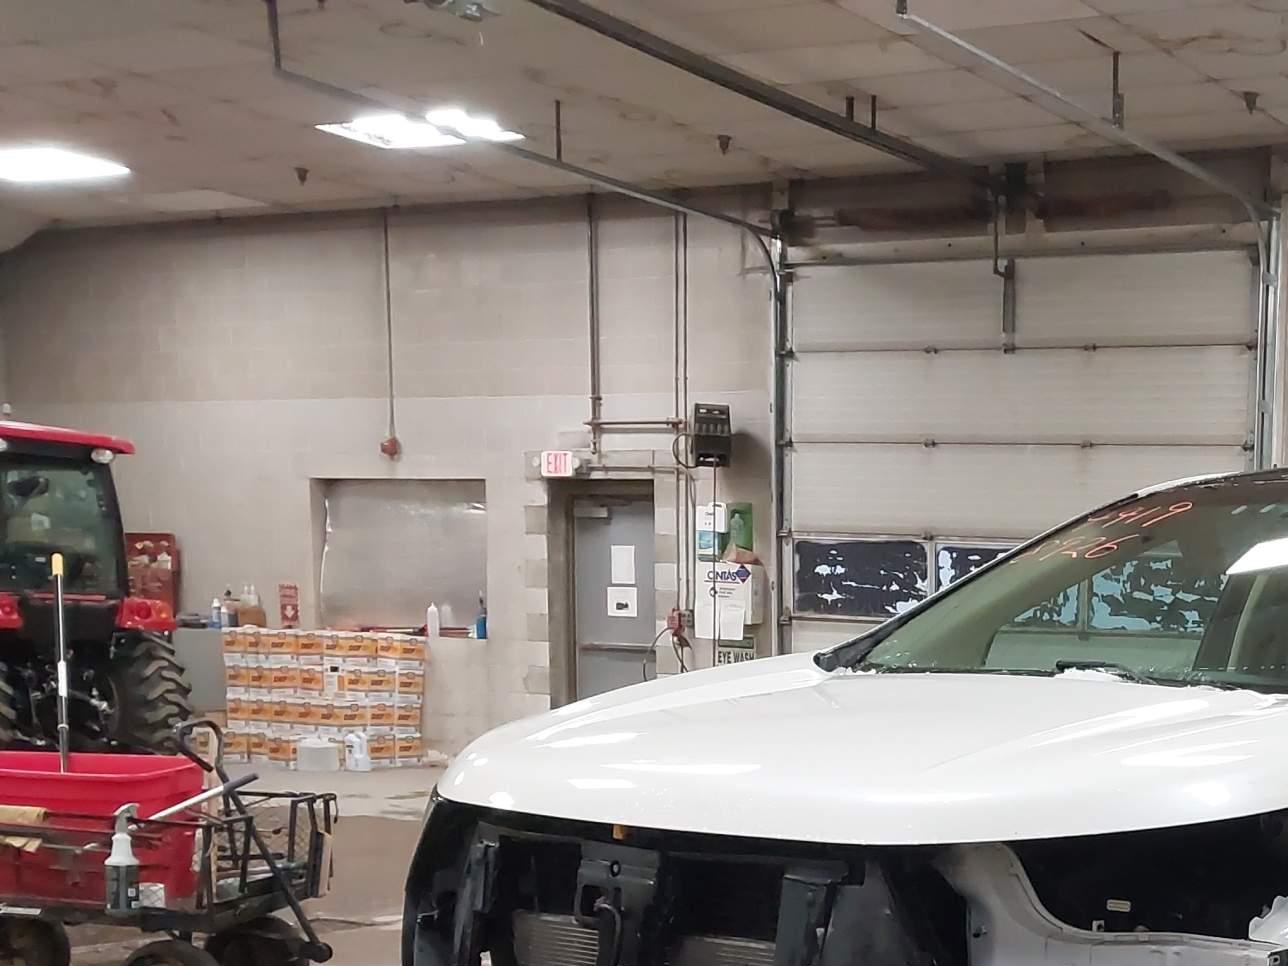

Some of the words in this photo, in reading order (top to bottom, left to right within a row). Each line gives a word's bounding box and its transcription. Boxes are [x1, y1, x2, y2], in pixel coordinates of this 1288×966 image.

[546, 452, 567, 473] EXIT
[707, 569, 737, 581] CNTAS
[718, 651, 731, 664] EYE
